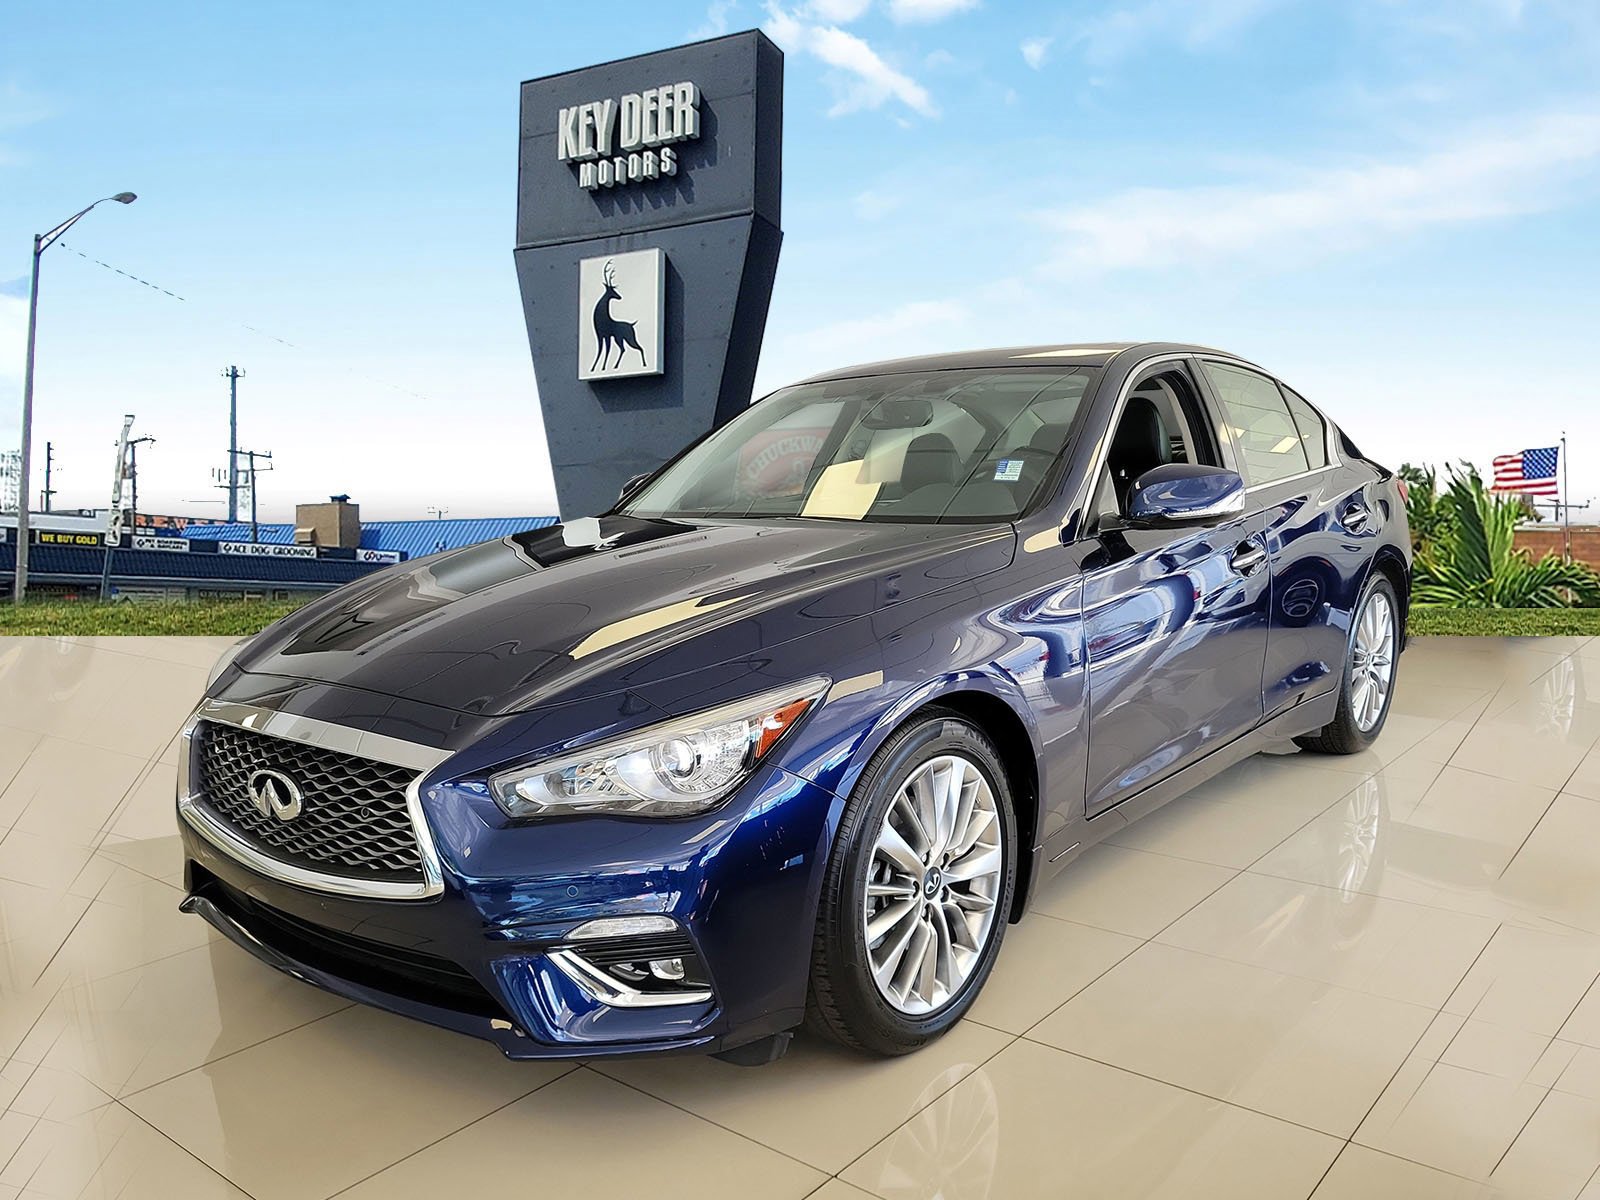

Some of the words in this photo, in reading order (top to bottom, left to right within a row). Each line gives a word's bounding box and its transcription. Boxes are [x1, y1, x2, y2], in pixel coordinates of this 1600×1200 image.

[558, 98, 617, 163] KEY
[620, 81, 699, 151] DEER
[579, 147, 677, 190] MOTORS
[41, 533, 55, 543] WE
[57, 533, 73, 544] BUY
[76, 534, 97, 545] GOLD
[233, 544, 246, 554] ACE
[251, 545, 269, 556] DOG
[273, 546, 315, 557] GROOMING
